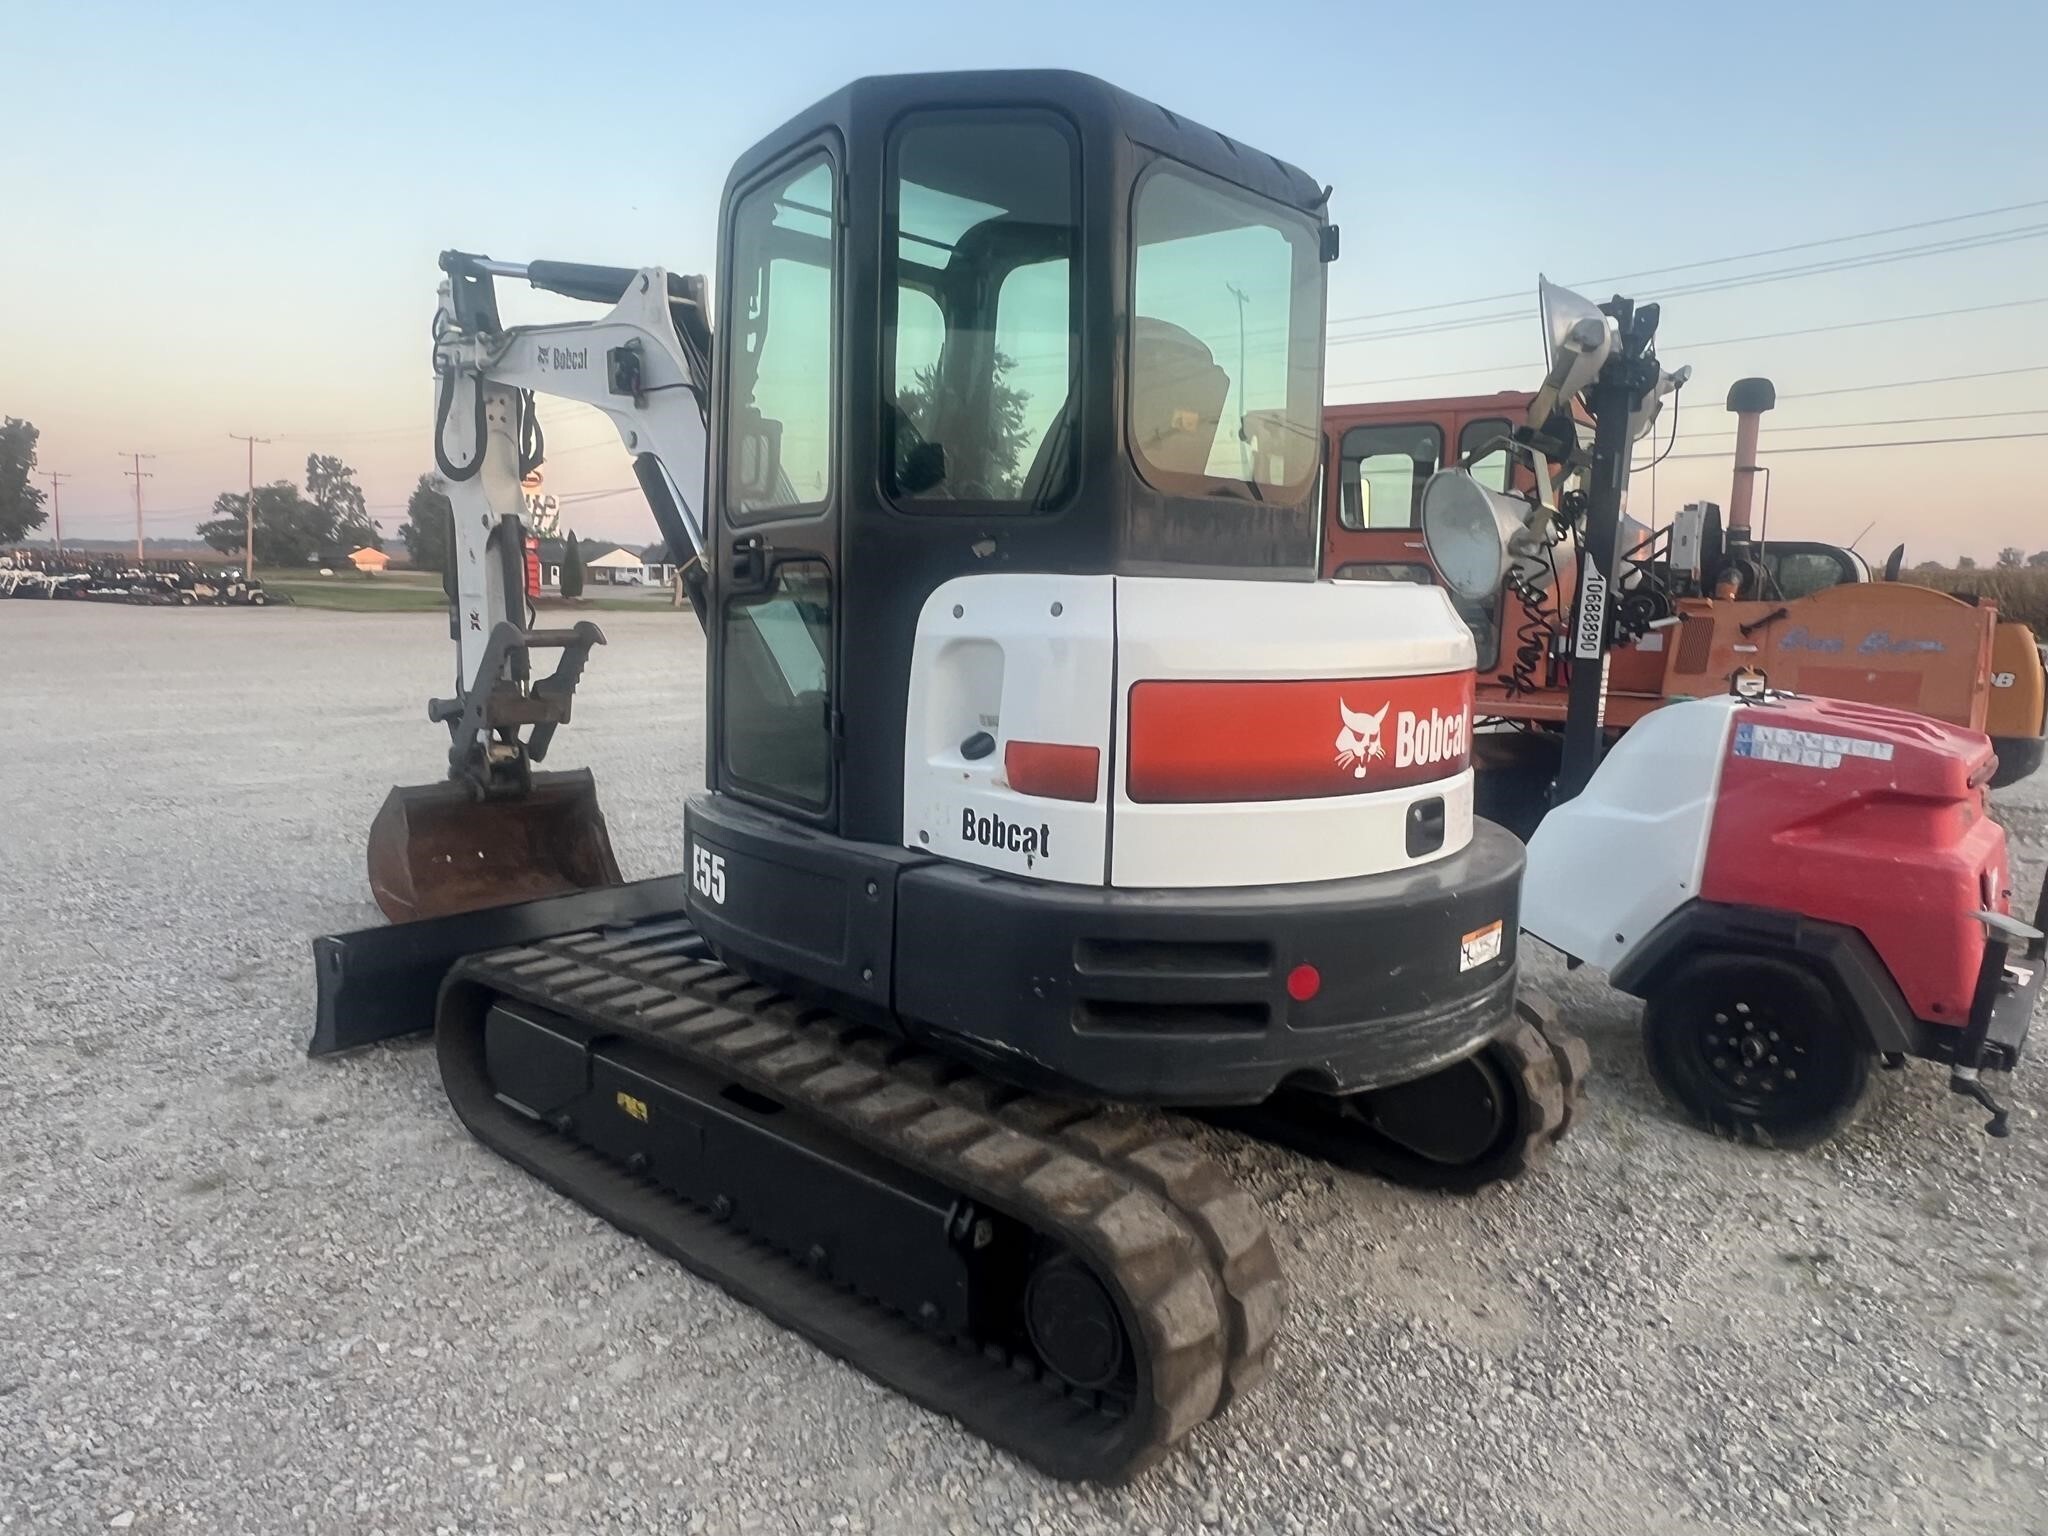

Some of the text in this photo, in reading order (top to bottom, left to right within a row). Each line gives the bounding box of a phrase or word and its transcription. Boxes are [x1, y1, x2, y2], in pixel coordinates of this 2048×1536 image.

[1395, 703, 1468, 769] Bobcat
[962, 807, 1049, 859] Bobcat
[693, 843, 726, 905] E55
